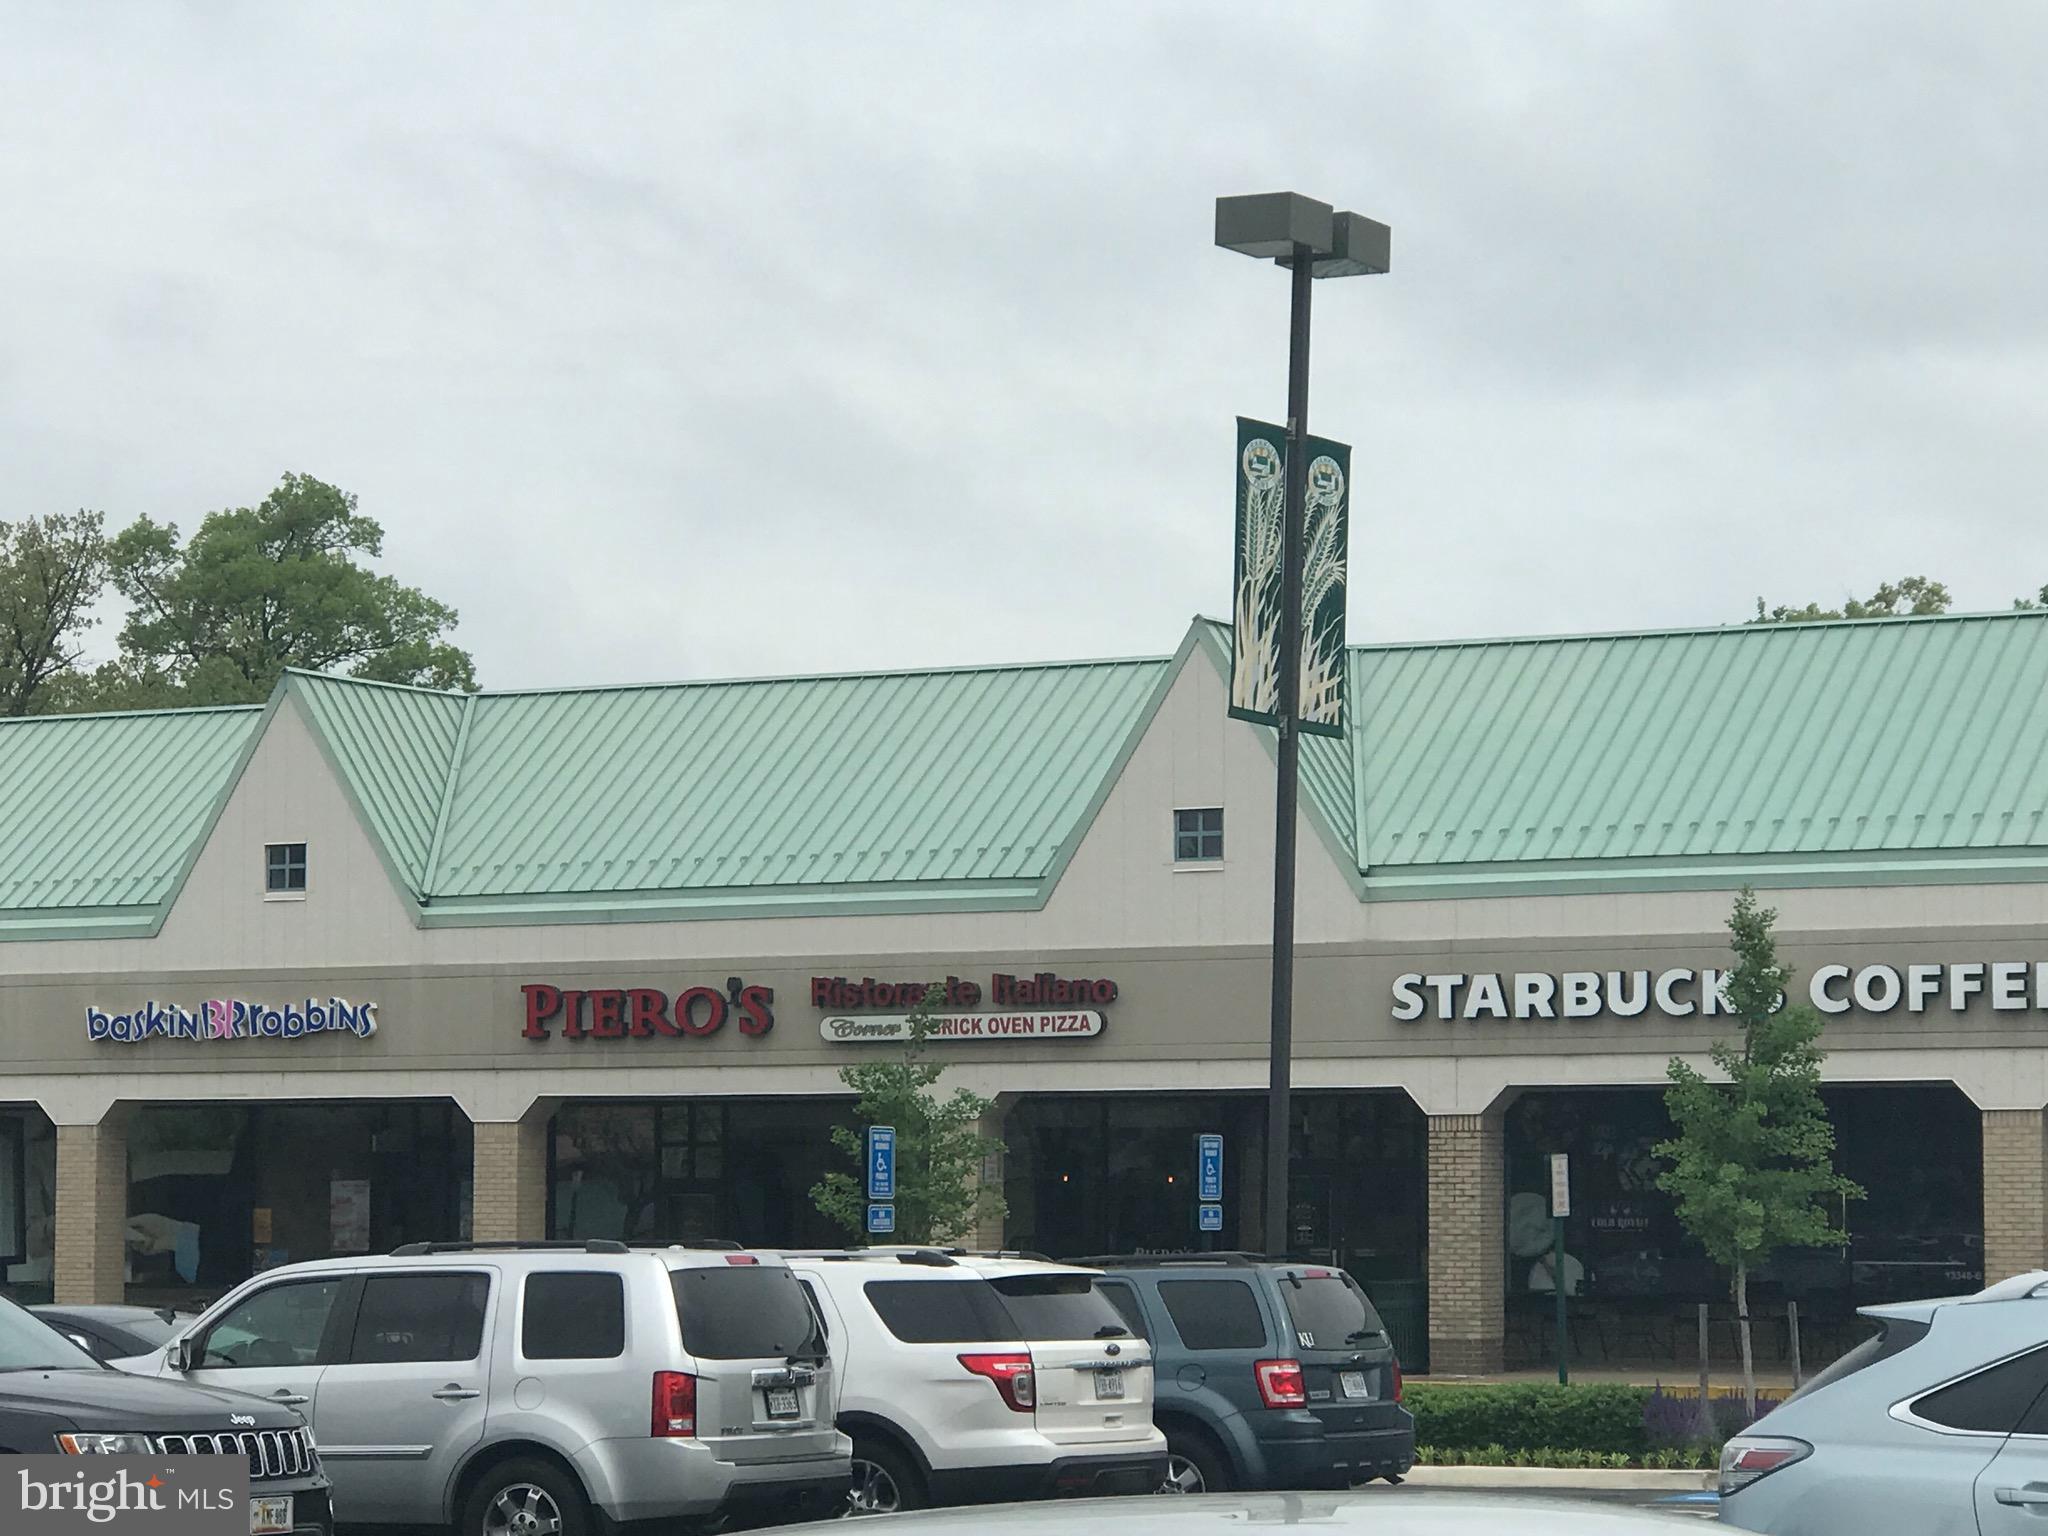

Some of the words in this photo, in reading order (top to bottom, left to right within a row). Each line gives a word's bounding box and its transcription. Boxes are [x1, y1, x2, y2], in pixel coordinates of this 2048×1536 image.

[811, 976, 982, 1007] Ristorate
[992, 973, 1118, 1004] Italiano
[988, 1016, 1035, 1034] OVEN
[1040, 1014, 1091, 1033] PIZZA
[231, 1413, 256, 1426] Jeep
